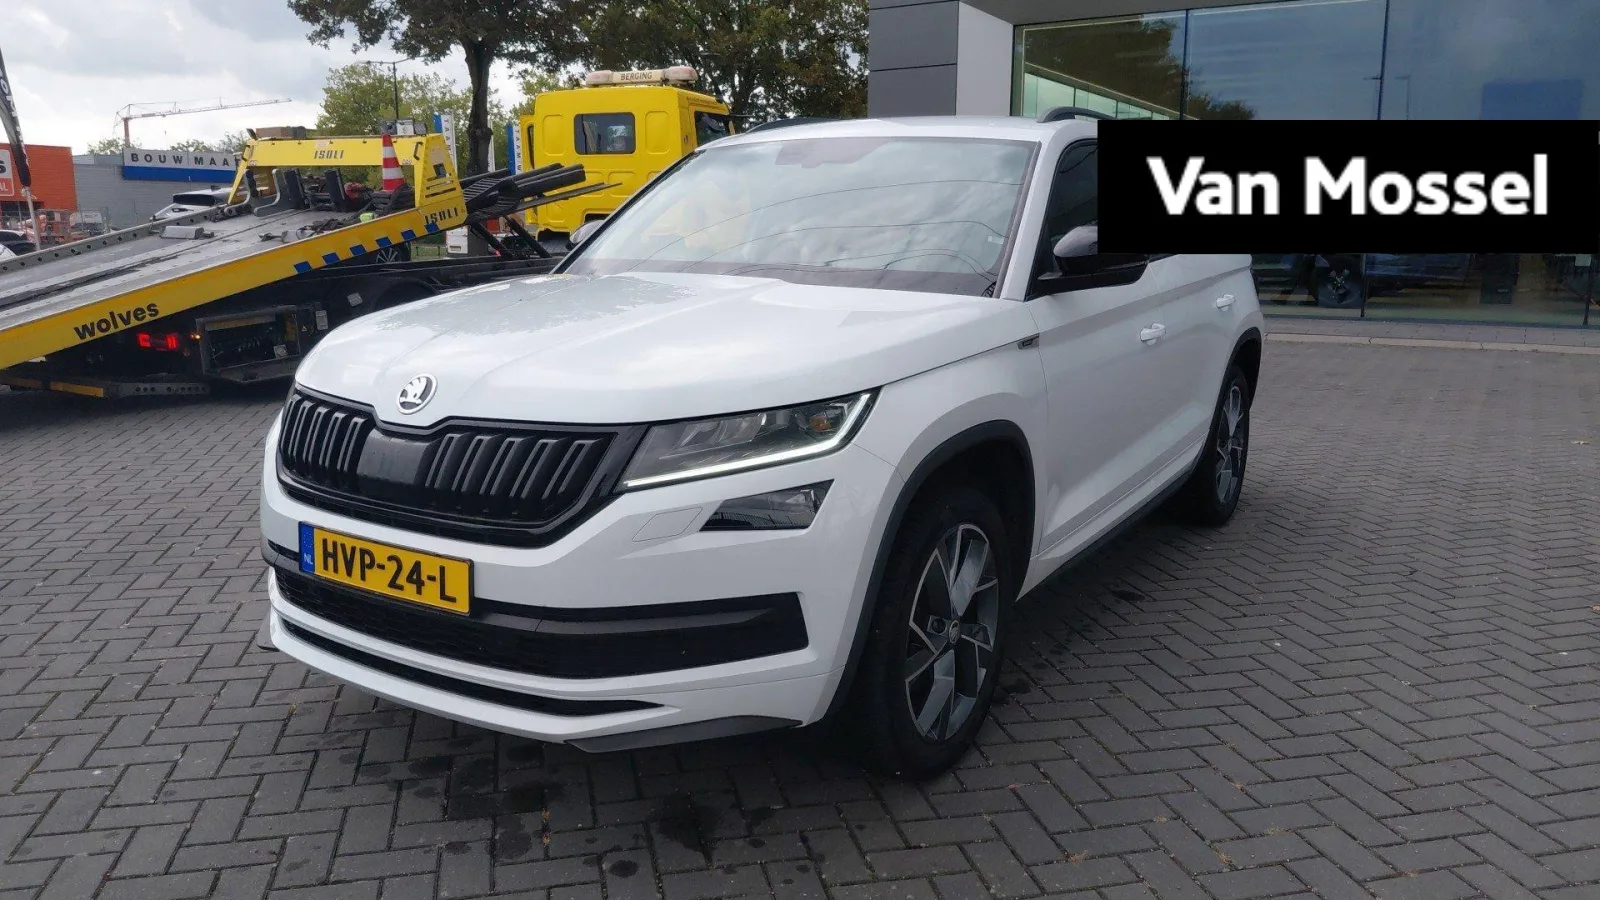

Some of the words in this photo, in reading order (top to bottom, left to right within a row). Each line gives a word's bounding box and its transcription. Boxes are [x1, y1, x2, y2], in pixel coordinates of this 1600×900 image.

[620, 72, 653, 81] BERGING
[314, 149, 344, 160] ISOLI
[425, 207, 459, 225] ISOLI
[73, 303, 159, 341] wolves
[303, 553, 314, 565] NL
[321, 537, 457, 604] HVP-24-L
